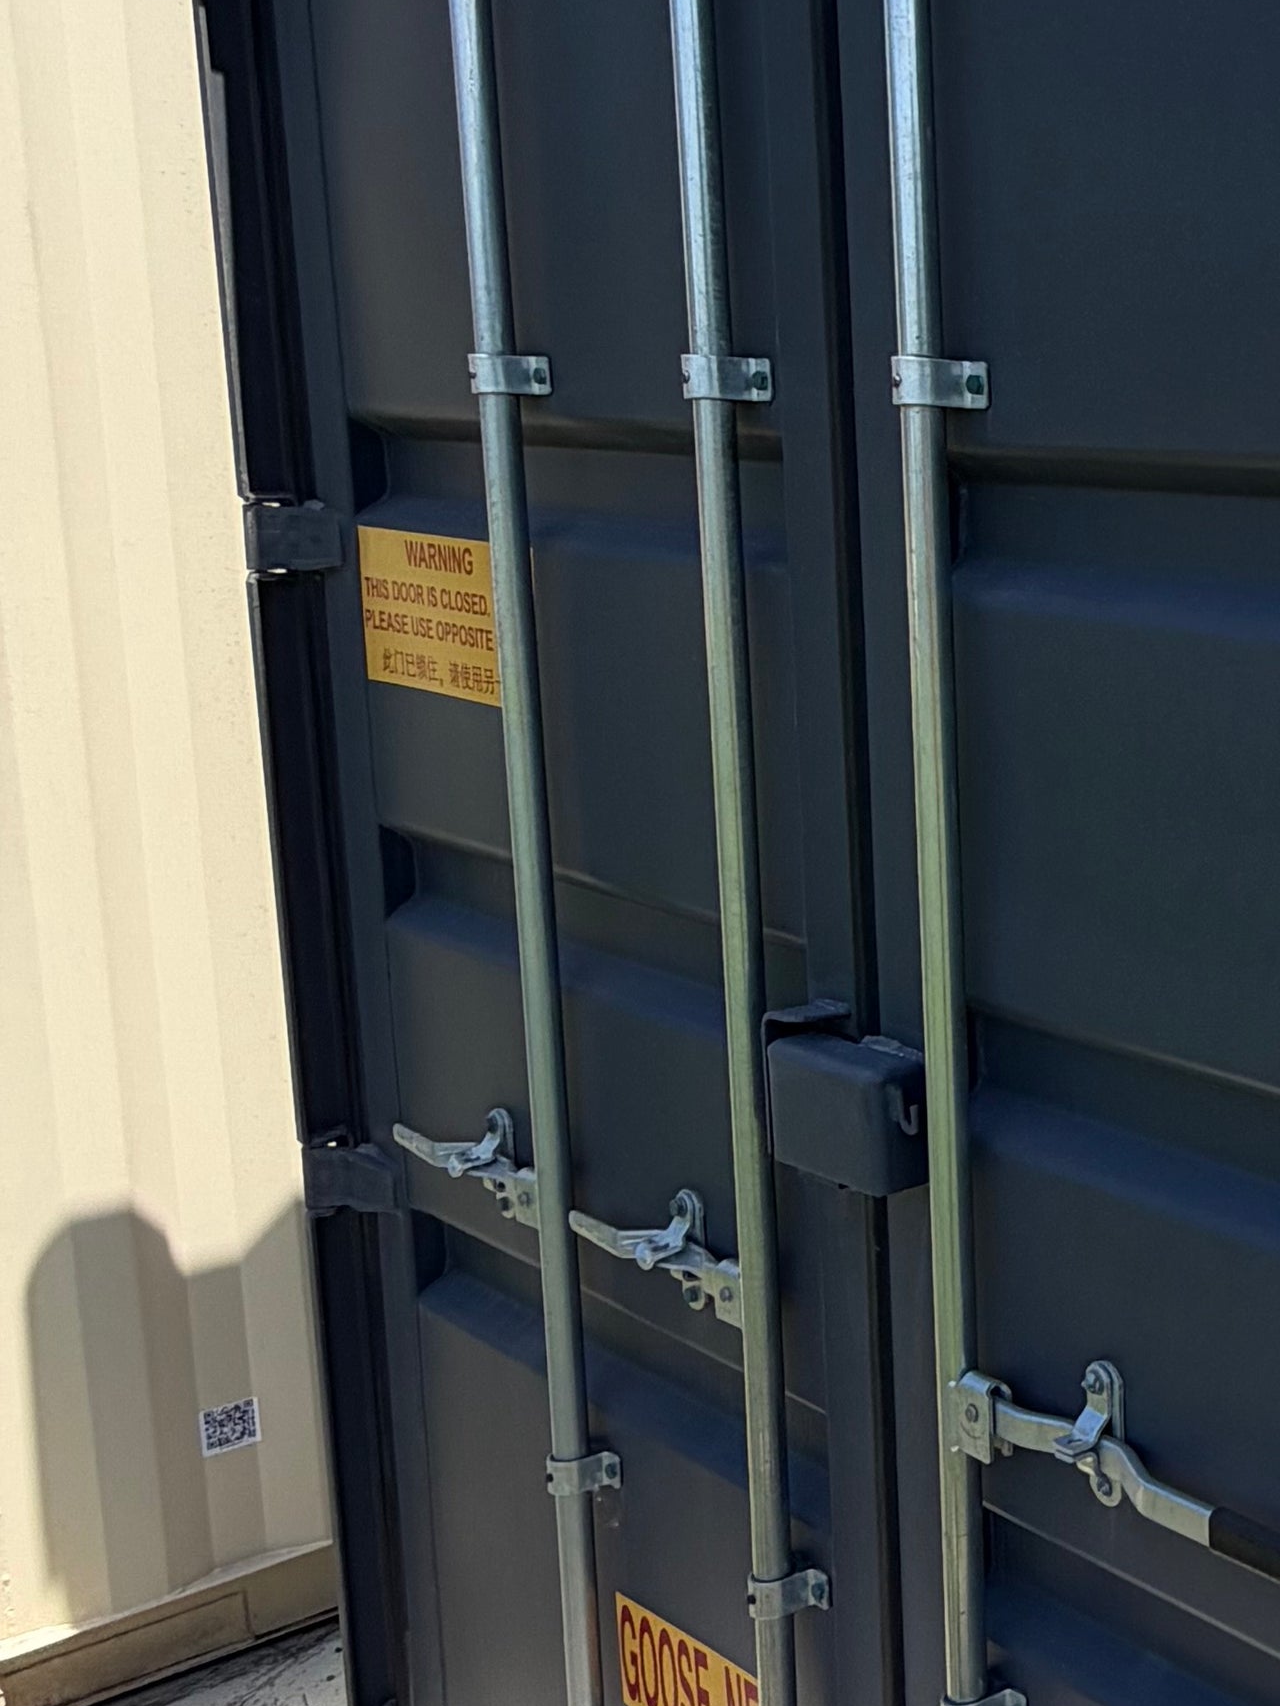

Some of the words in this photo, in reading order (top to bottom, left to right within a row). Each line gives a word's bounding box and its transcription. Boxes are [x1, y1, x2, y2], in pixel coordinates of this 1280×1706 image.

[405, 540, 474, 576] WARNING
[364, 576, 389, 601] THIS
[392, 580, 424, 604] DOOR
[427, 585, 438, 608] IS
[440, 588, 491, 618] CLOSED.
[365, 609, 409, 635] PLEASE
[412, 617, 434, 640] USE
[436, 621, 494, 651] OPPOSITE
